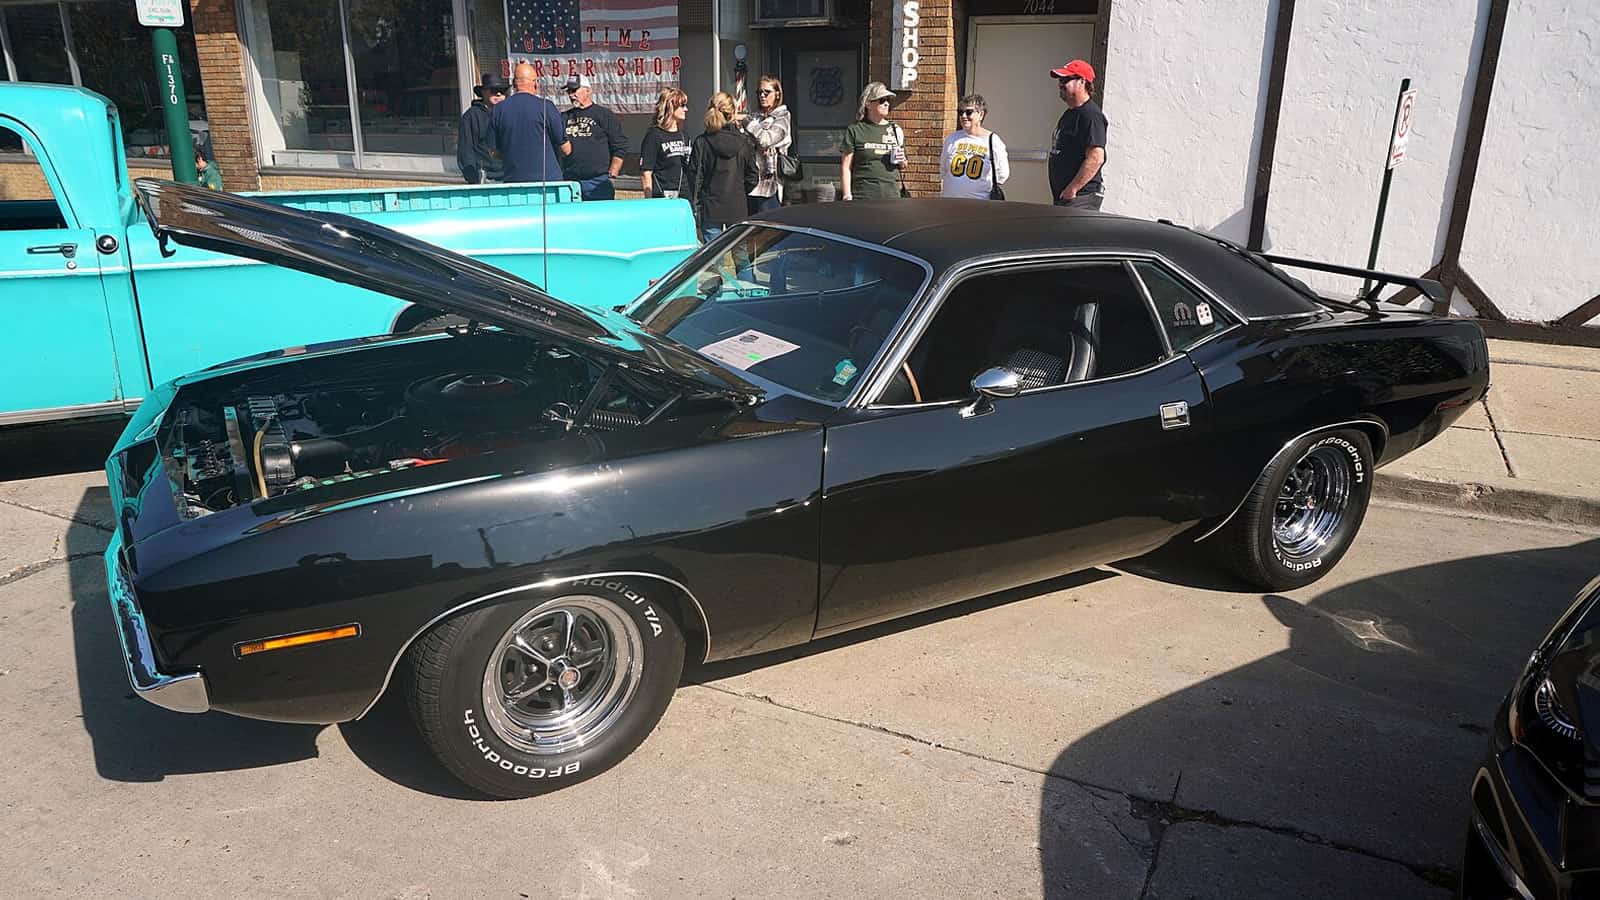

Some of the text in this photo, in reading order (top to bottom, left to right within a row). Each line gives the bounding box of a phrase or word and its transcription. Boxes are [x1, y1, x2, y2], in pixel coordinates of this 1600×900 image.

[523, 26, 653, 52] OLD TIME
[901, 0, 920, 89] SHOP
[500, 56, 682, 79] BRBER SHOP
[951, 153, 984, 180] GO
[1282, 557, 1322, 572] Radial
[644, 605, 663, 638] T/A
[464, 709, 580, 778] BFGoodrich
